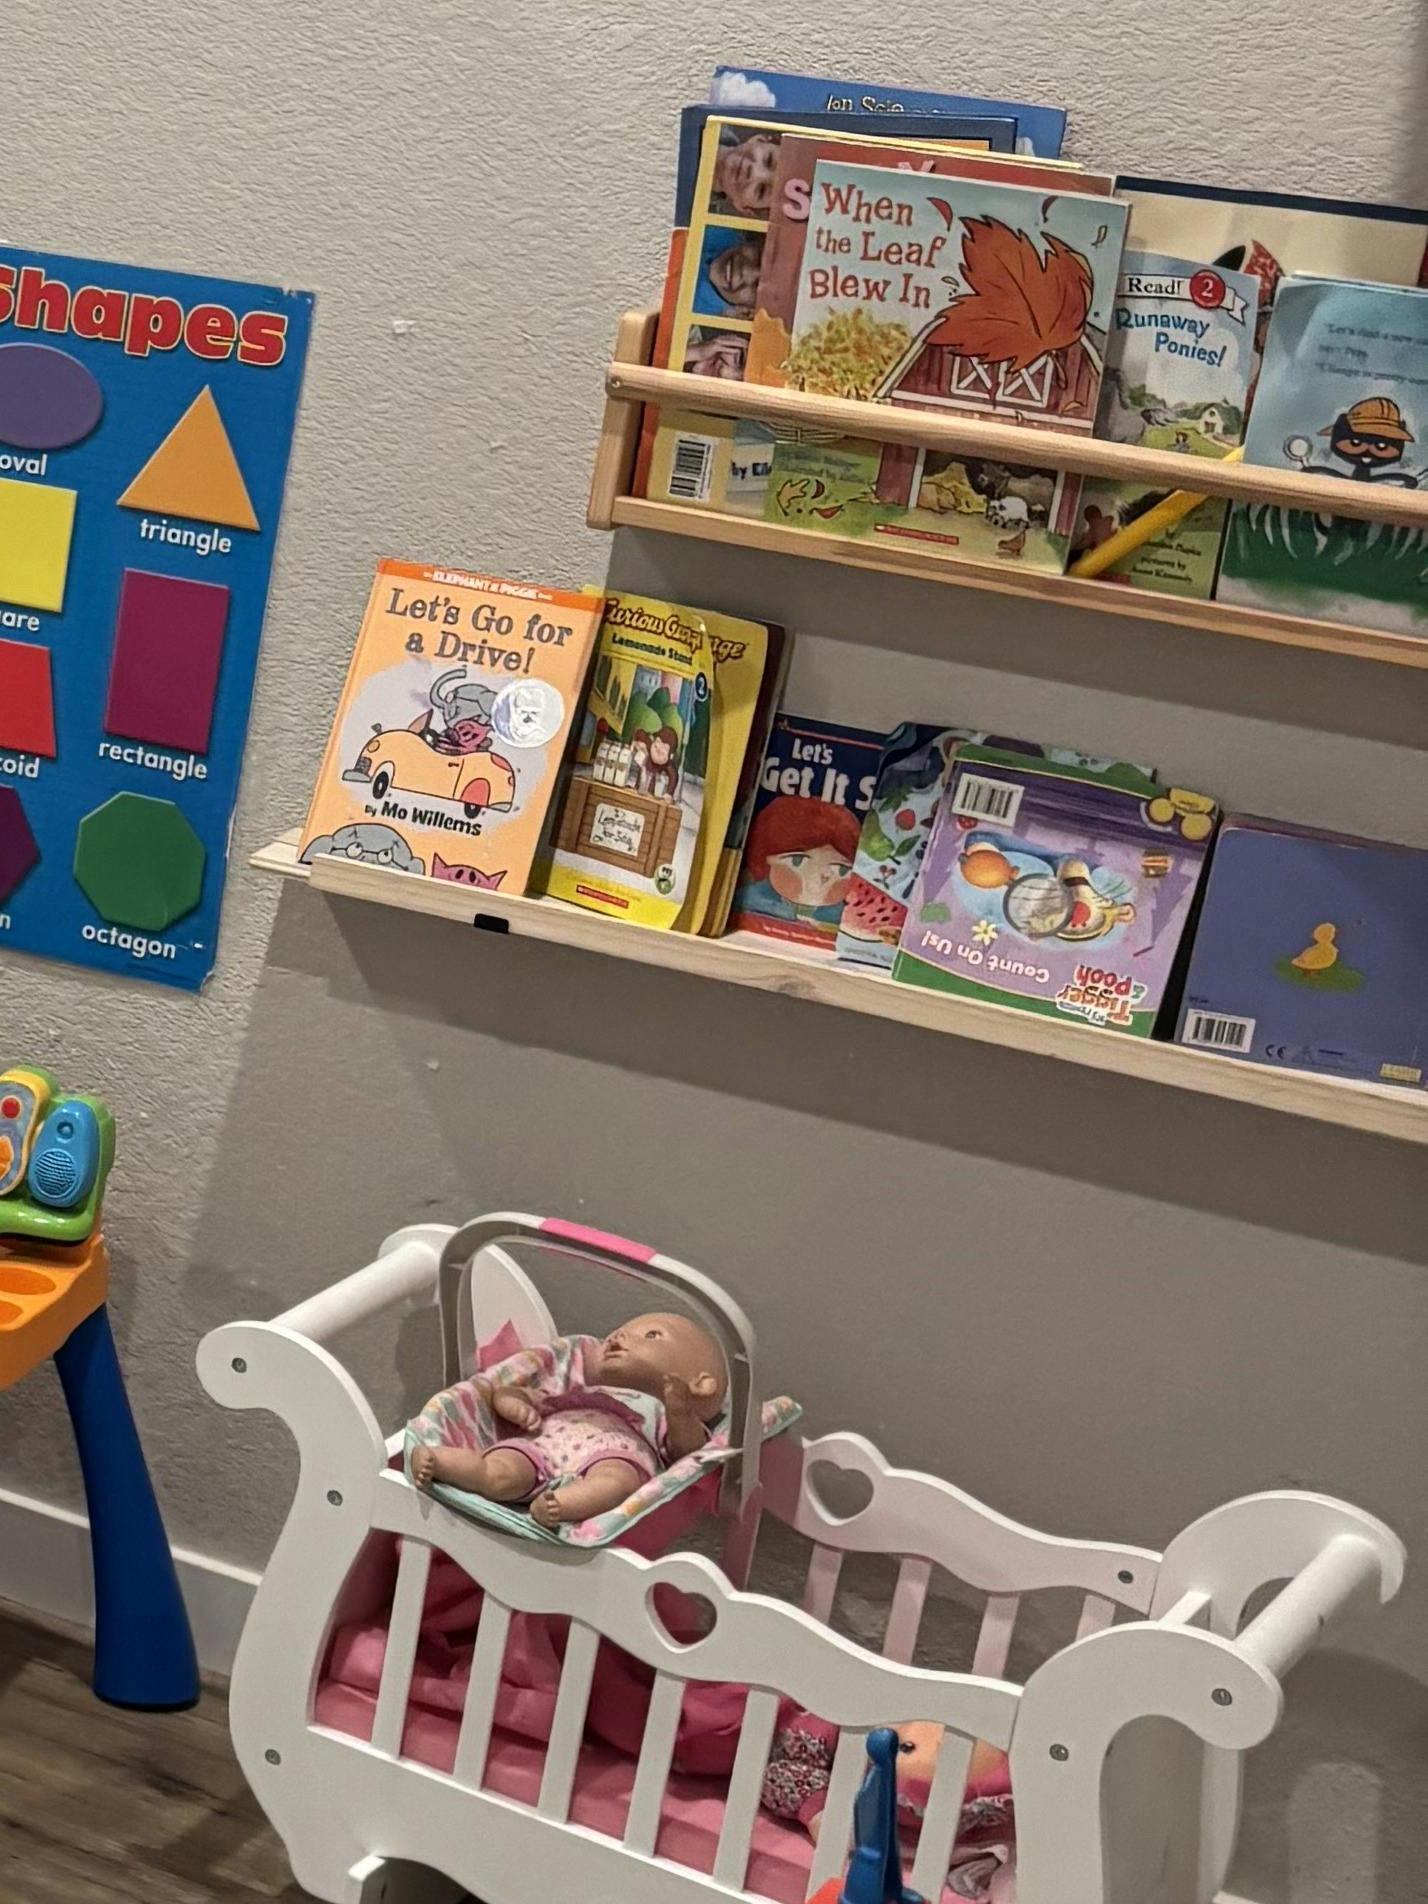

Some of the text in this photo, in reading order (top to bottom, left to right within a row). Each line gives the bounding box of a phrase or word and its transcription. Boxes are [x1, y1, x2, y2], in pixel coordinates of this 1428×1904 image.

[820, 182, 913, 227] When
[815, 227, 947, 269] the Leaf
[809, 270, 931, 309] Blew In
[1127, 276, 1181, 295] Read!
[1202, 280, 1214, 297] 2
[1115, 308, 1209, 338] Runaway
[1155, 331, 1227, 367] Ponies!
[139, 518, 232, 557] triangle
[432, 571, 490, 591] ELEPHANT
[385, 587, 573, 647] Let's Go for
[405, 631, 536, 674] a Drive!
[612, 632, 666, 656] Lemonade
[98, 739, 209, 782] rectangle
[792, 738, 833, 765] Let's
[760, 757, 814, 798] Get
[820, 770, 850, 807] It
[364, 801, 482, 836] By Mo Willems
[80, 921, 177, 961] octagon
[921, 930, 952, 955] Us!
[958, 944, 983, 965] On
[988, 956, 1049, 983] Count
[1074, 965, 1133, 997] Pooh
[1058, 985, 1131, 1024] Tigger
